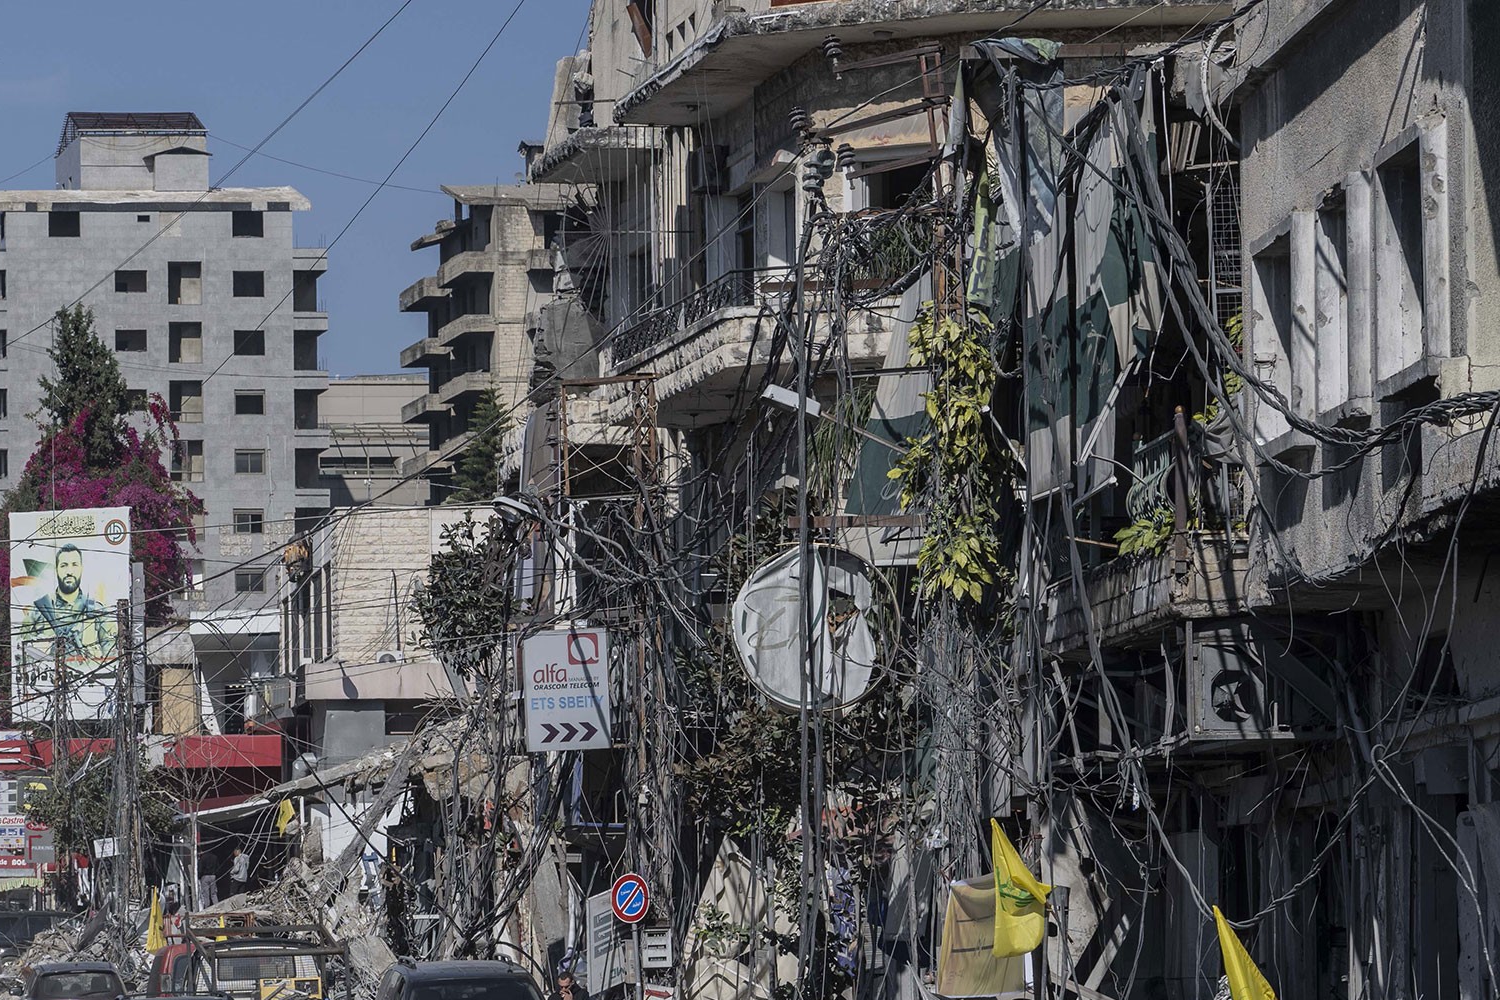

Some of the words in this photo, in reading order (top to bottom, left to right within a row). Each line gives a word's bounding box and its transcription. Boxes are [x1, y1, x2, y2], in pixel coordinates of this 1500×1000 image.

[533, 663, 567, 684] alfa
[531, 697, 555, 710] ETS
[559, 695, 604, 709] SBEITY
[1, 817, 25, 825] Castro
